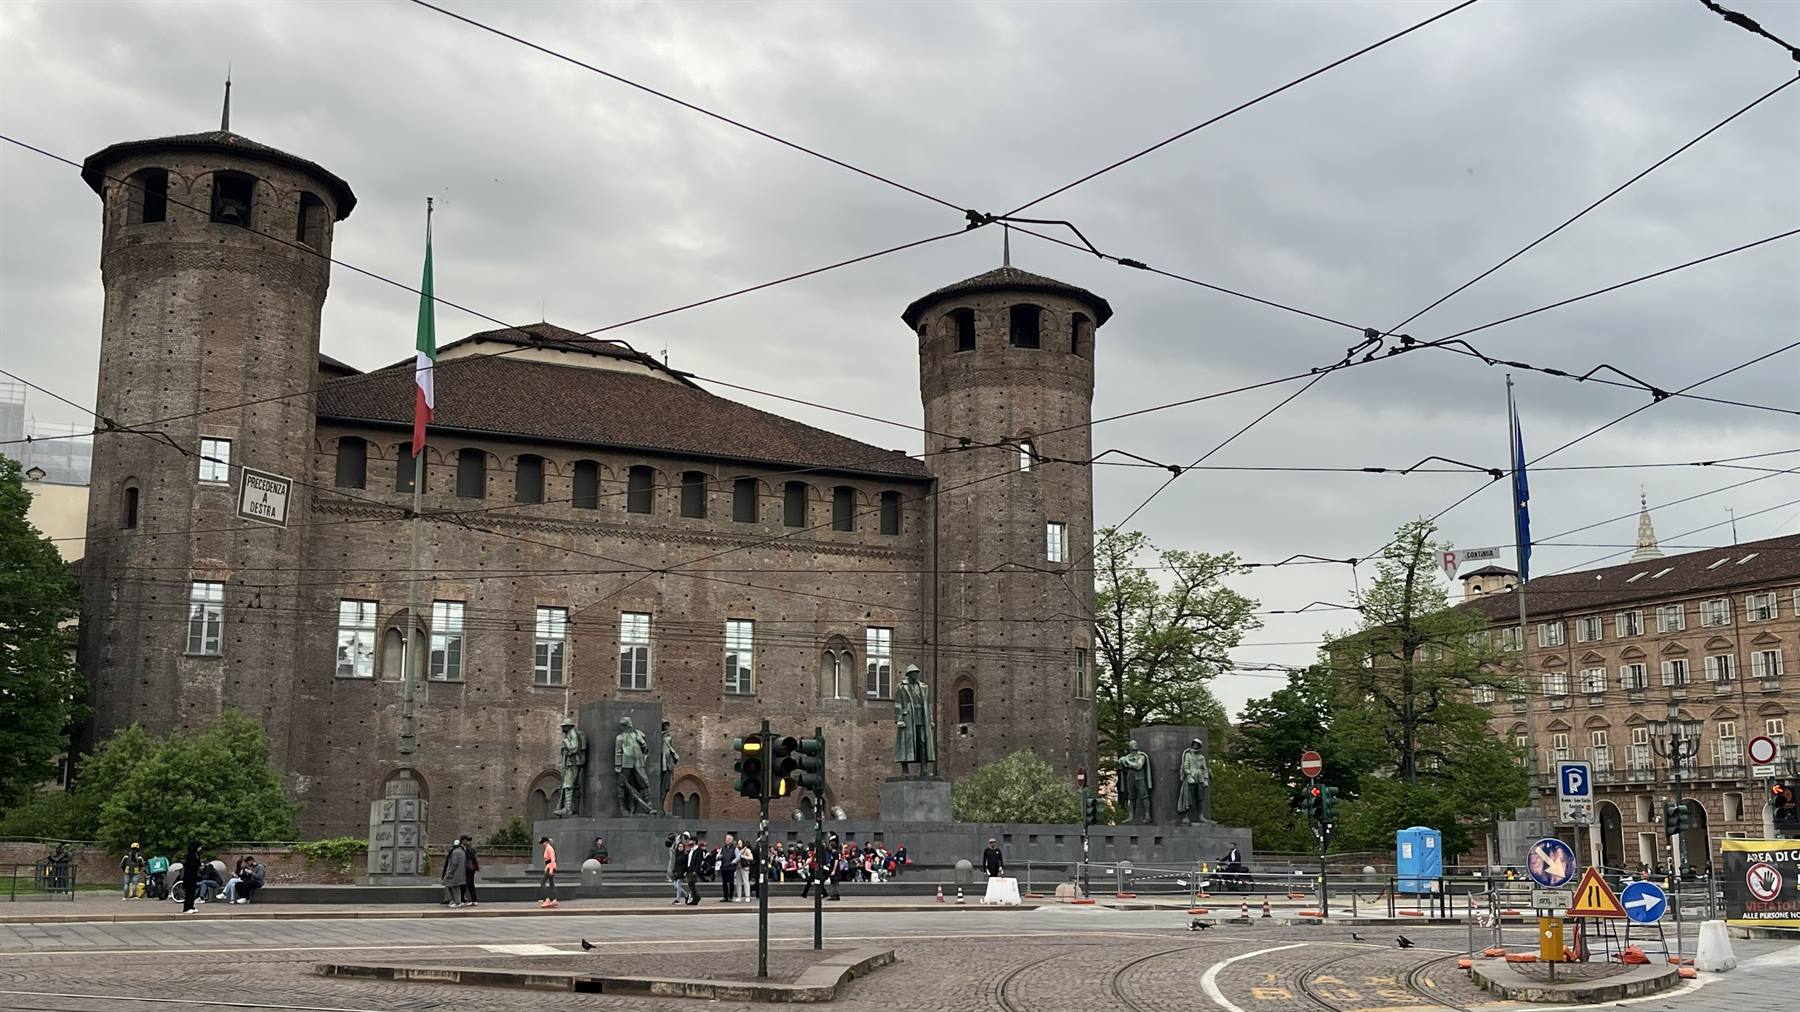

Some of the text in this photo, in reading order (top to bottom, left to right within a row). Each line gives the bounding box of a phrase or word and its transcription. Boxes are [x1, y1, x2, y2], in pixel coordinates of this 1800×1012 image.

[246, 475, 286, 496] PRECEDENZA
[262, 492, 268, 504] A
[250, 501, 276, 518] DESTRA
[1443, 552, 1456, 570] R
[1747, 851, 1800, 862] AREA DI C
[1746, 902, 1791, 911] VIETATO
[1759, 911, 1789, 919] PERSONE
[1251, 987, 1424, 1003] BUS
